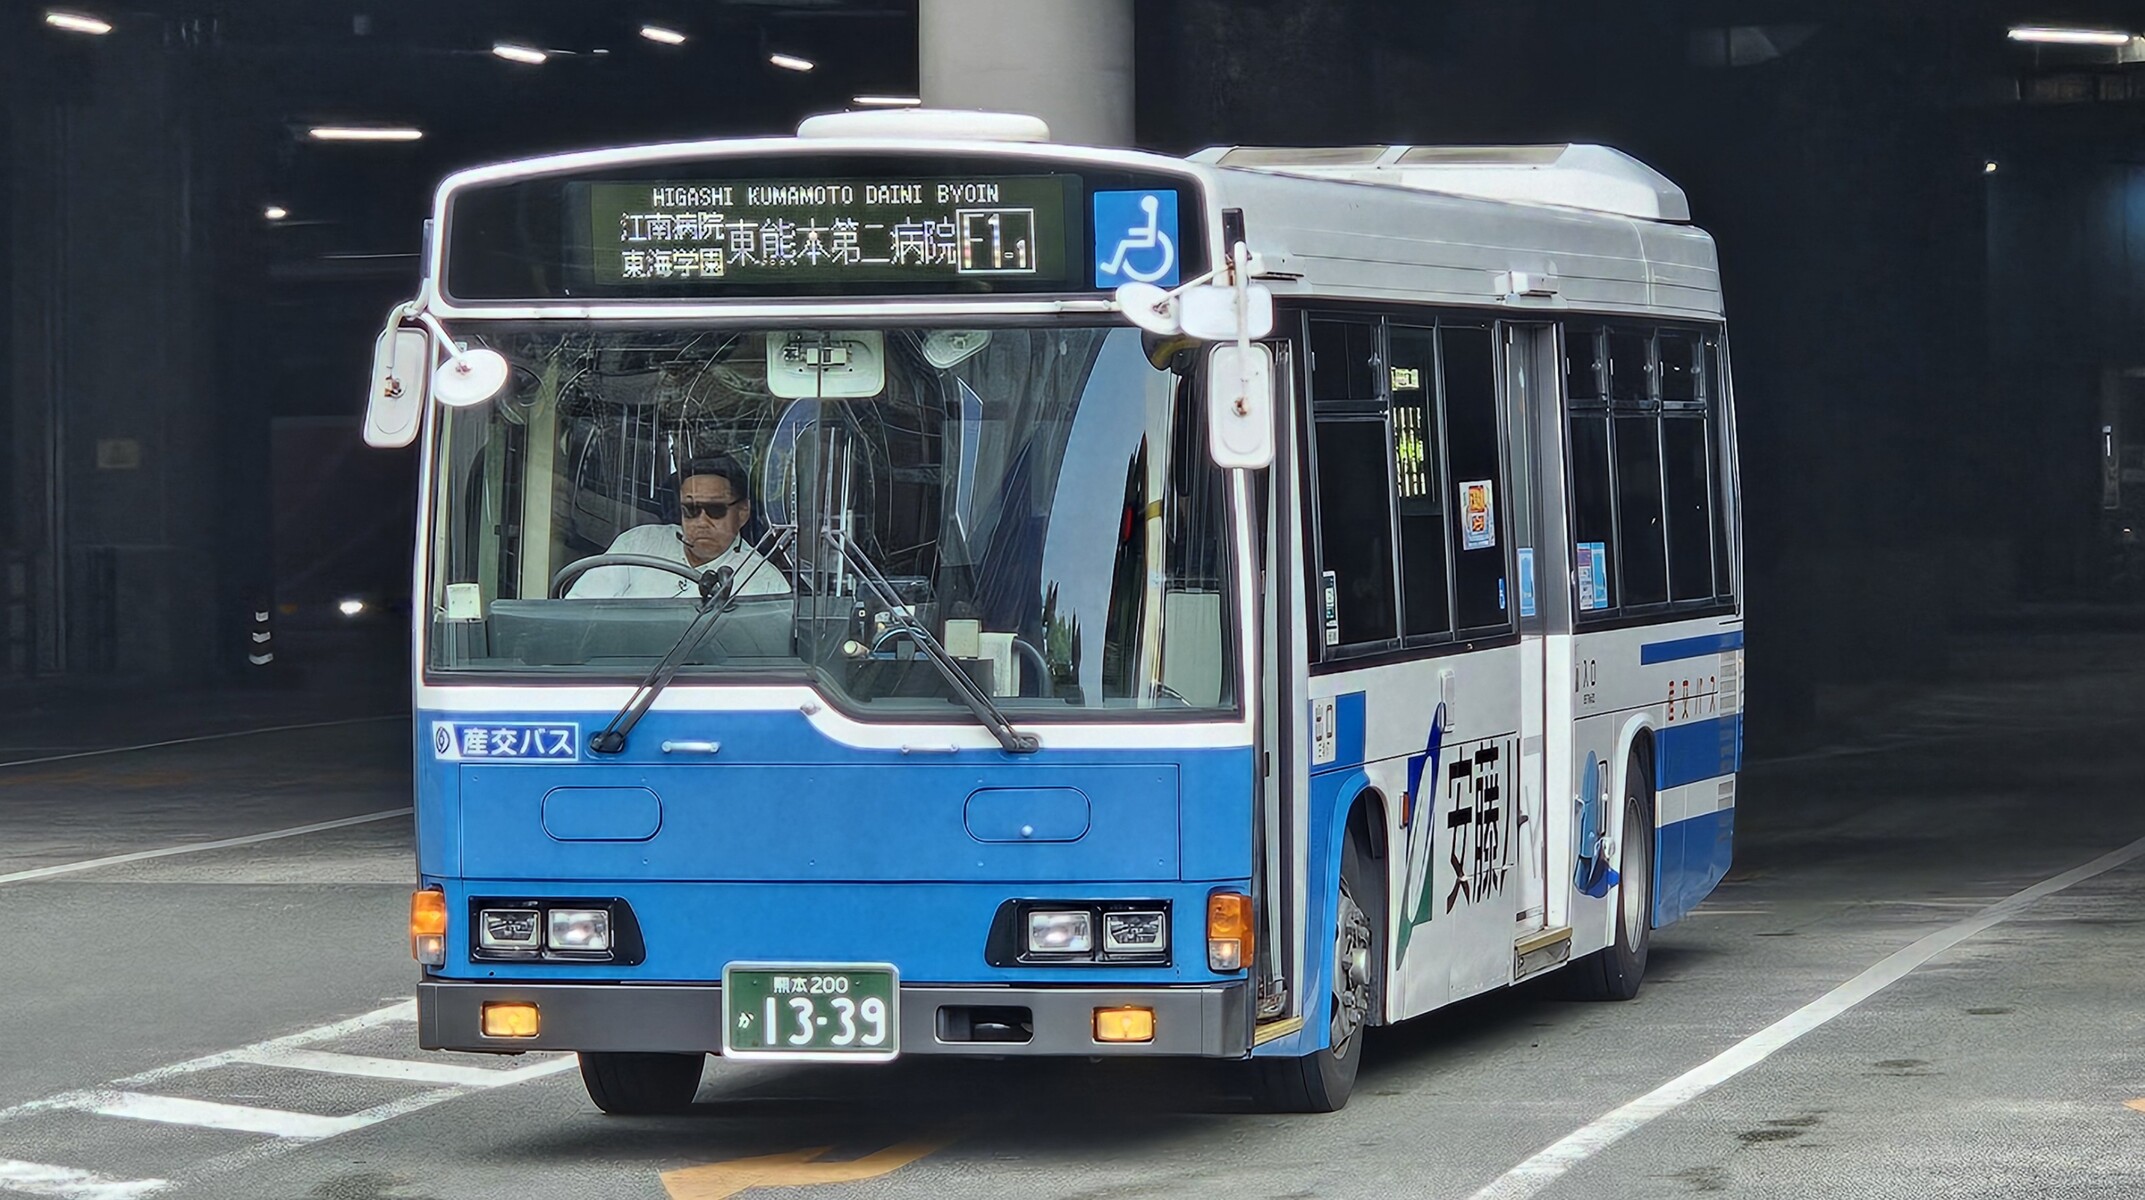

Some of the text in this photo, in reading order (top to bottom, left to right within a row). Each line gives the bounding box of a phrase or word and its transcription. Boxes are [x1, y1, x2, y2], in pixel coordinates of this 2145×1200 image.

[653, 183, 999, 207] HIGASHI KUMAMOTO DAINI BYOIN
[621, 211, 725, 242] 江南病院
[725, 216, 957, 267] 東熊本第二病院
[963, 212, 1027, 269] F1-1
[621, 247, 725, 279] 東海学園
[462, 727, 573, 755] 産交バス
[766, 997, 886, 1046] 13-39
